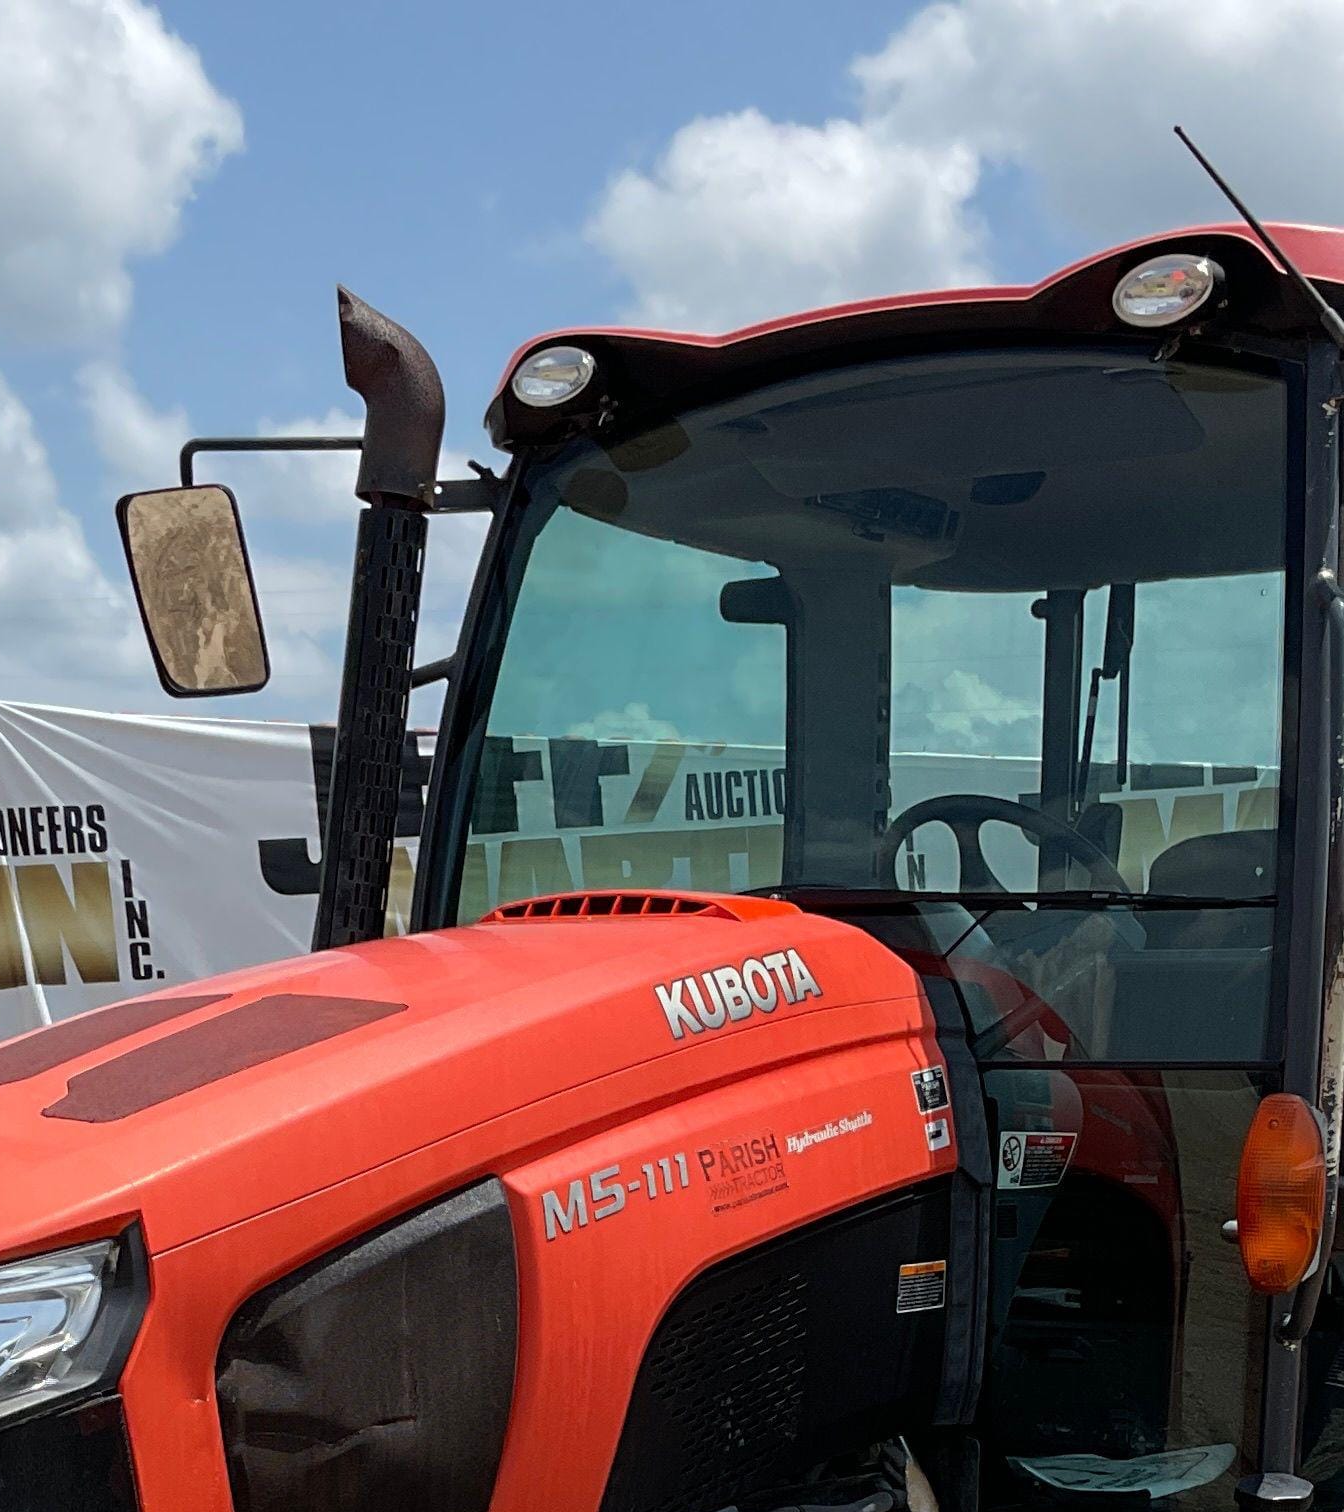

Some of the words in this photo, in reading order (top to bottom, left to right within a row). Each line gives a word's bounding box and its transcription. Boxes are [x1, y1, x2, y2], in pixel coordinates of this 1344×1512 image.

[121, 859, 166, 981] INC.
[654, 948, 823, 1040] KUBOTA
[696, 1133, 782, 1182] PARISH
[786, 1122, 840, 1154] Hydraulic
[541, 1152, 690, 1242] M5-111
[732, 1162, 787, 1194] TRACTOR
